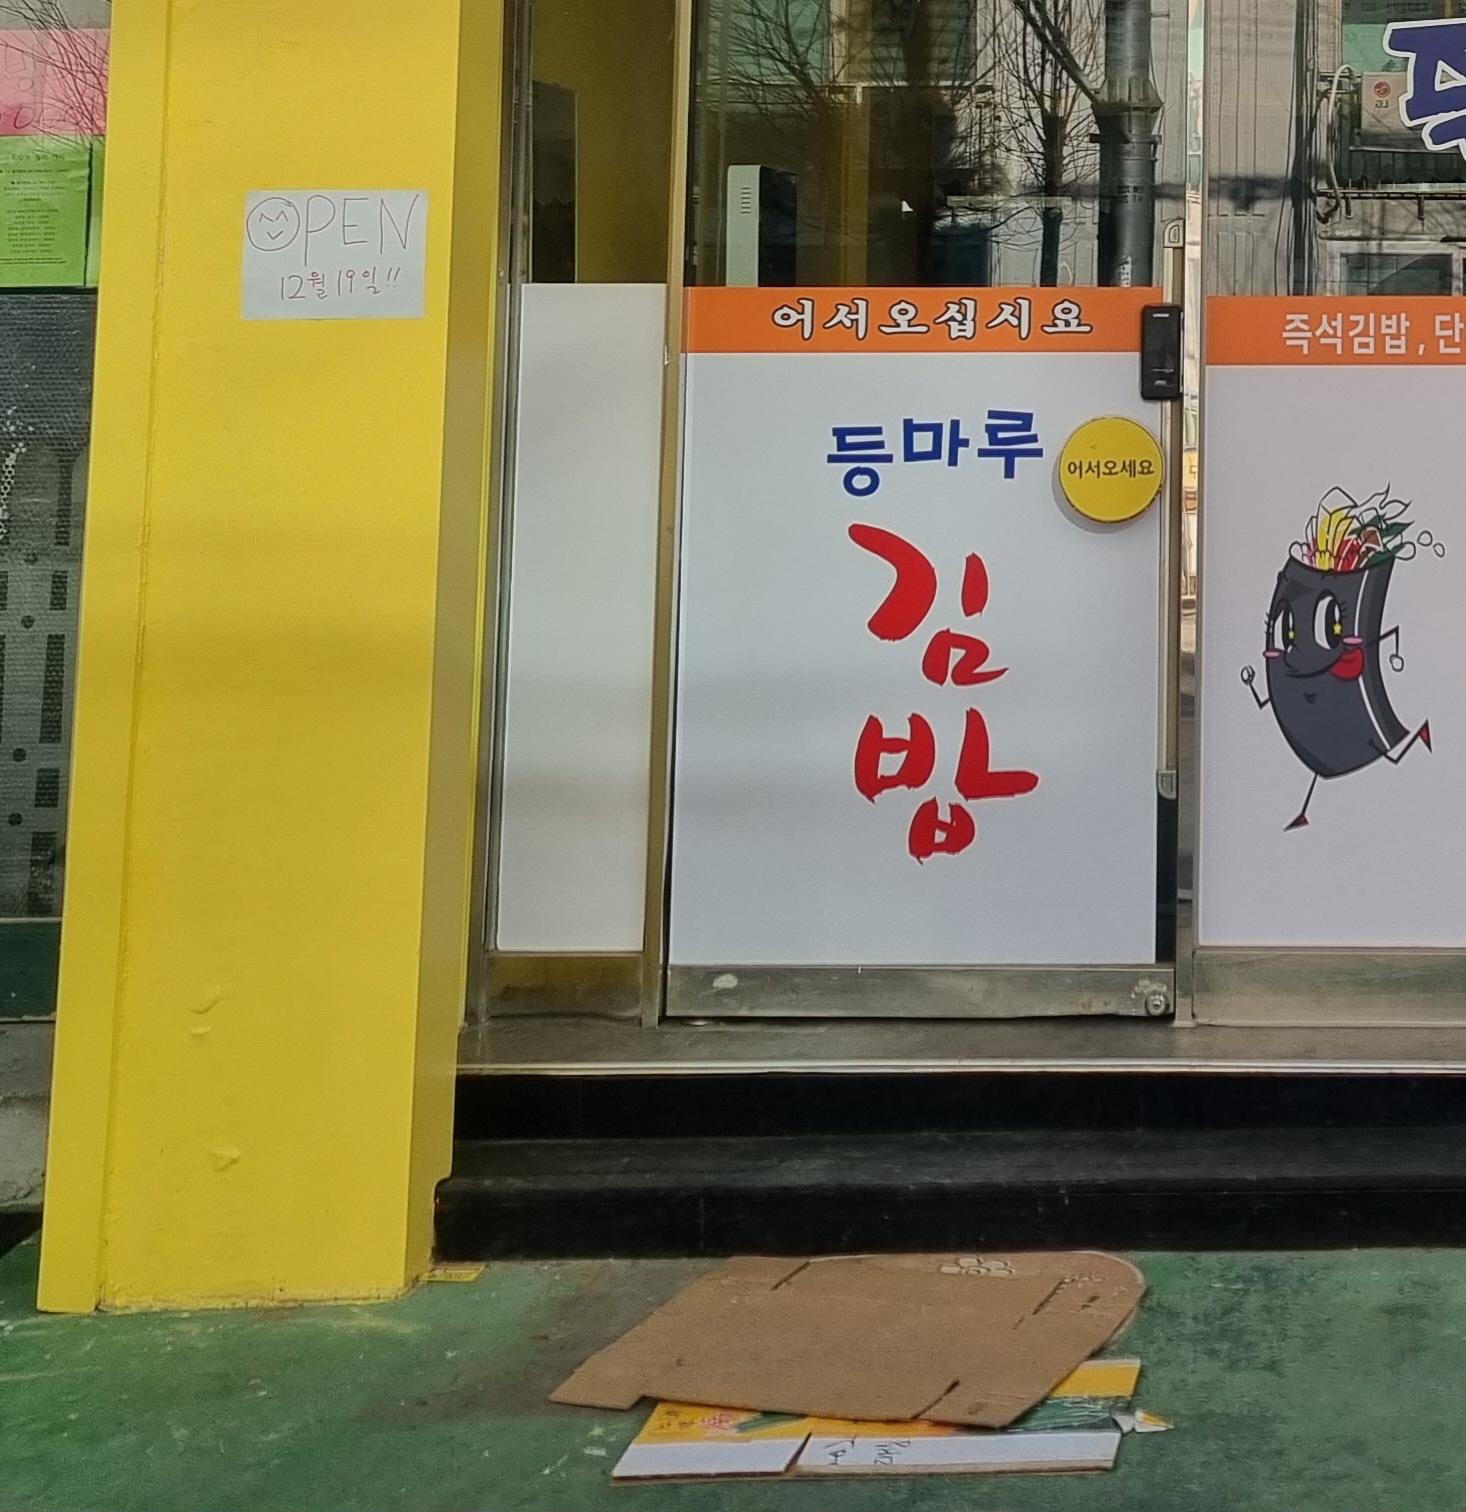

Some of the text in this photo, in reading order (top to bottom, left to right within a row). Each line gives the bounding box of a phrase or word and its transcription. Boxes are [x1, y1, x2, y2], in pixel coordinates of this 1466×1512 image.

[246, 194, 419, 267] OPEN
[771, 297, 1092, 340] 어서오십시요
[827, 410, 1044, 497] 등마루
[1067, 459, 1154, 479] 어서오세요
